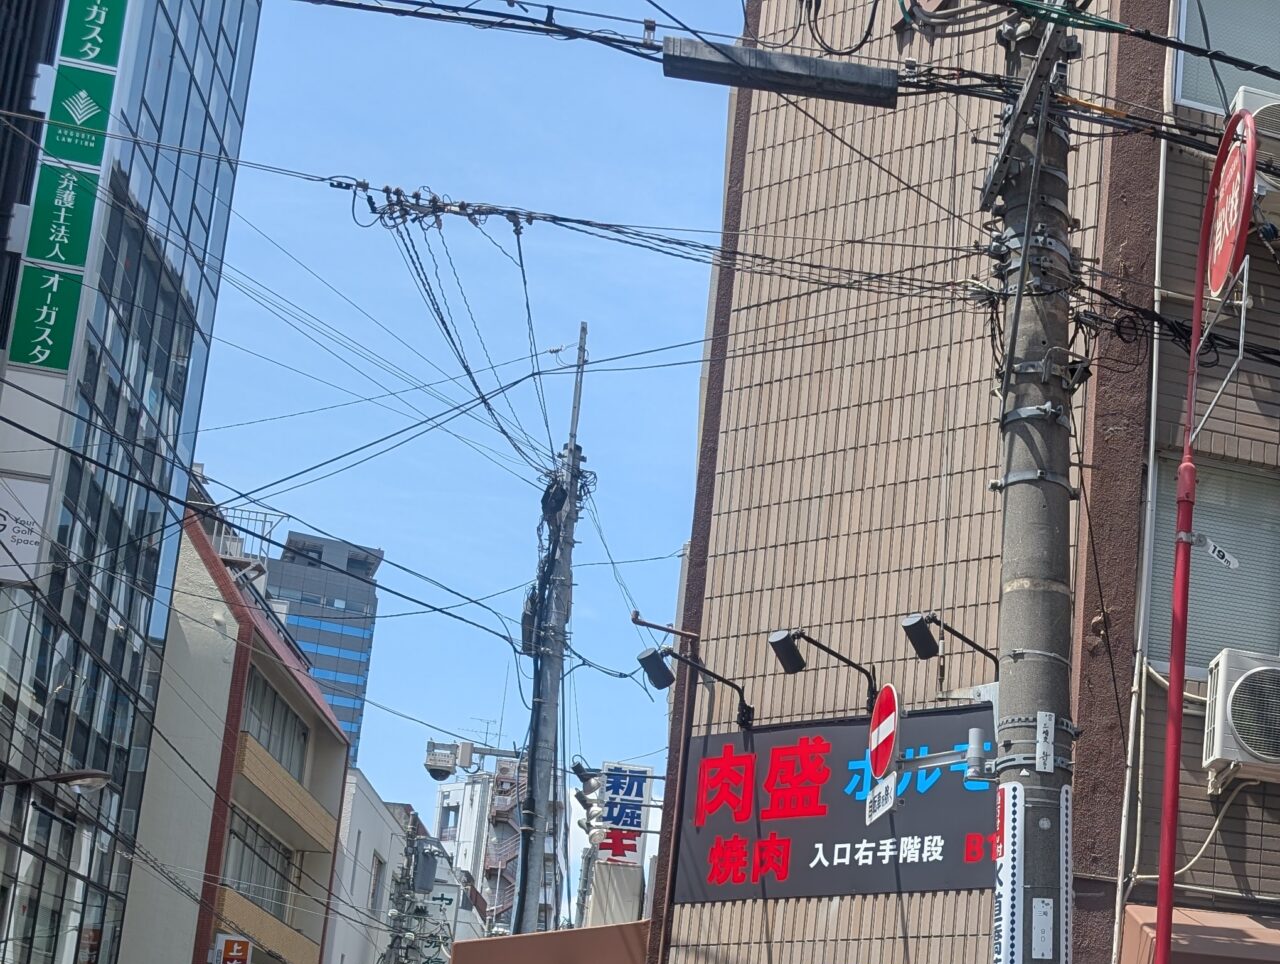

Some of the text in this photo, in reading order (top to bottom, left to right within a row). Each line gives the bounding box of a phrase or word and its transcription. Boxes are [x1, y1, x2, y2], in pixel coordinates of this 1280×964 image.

[49, 174, 79, 261] 弁護士法人
[28, 273, 64, 365] オーガスタ
[10, 535, 41, 547] Space
[12, 525, 34, 537] Golf
[694, 735, 833, 827] 肉盛
[707, 832, 792, 886] 焼肉
[809, 835, 944, 869] 入口右手階段
